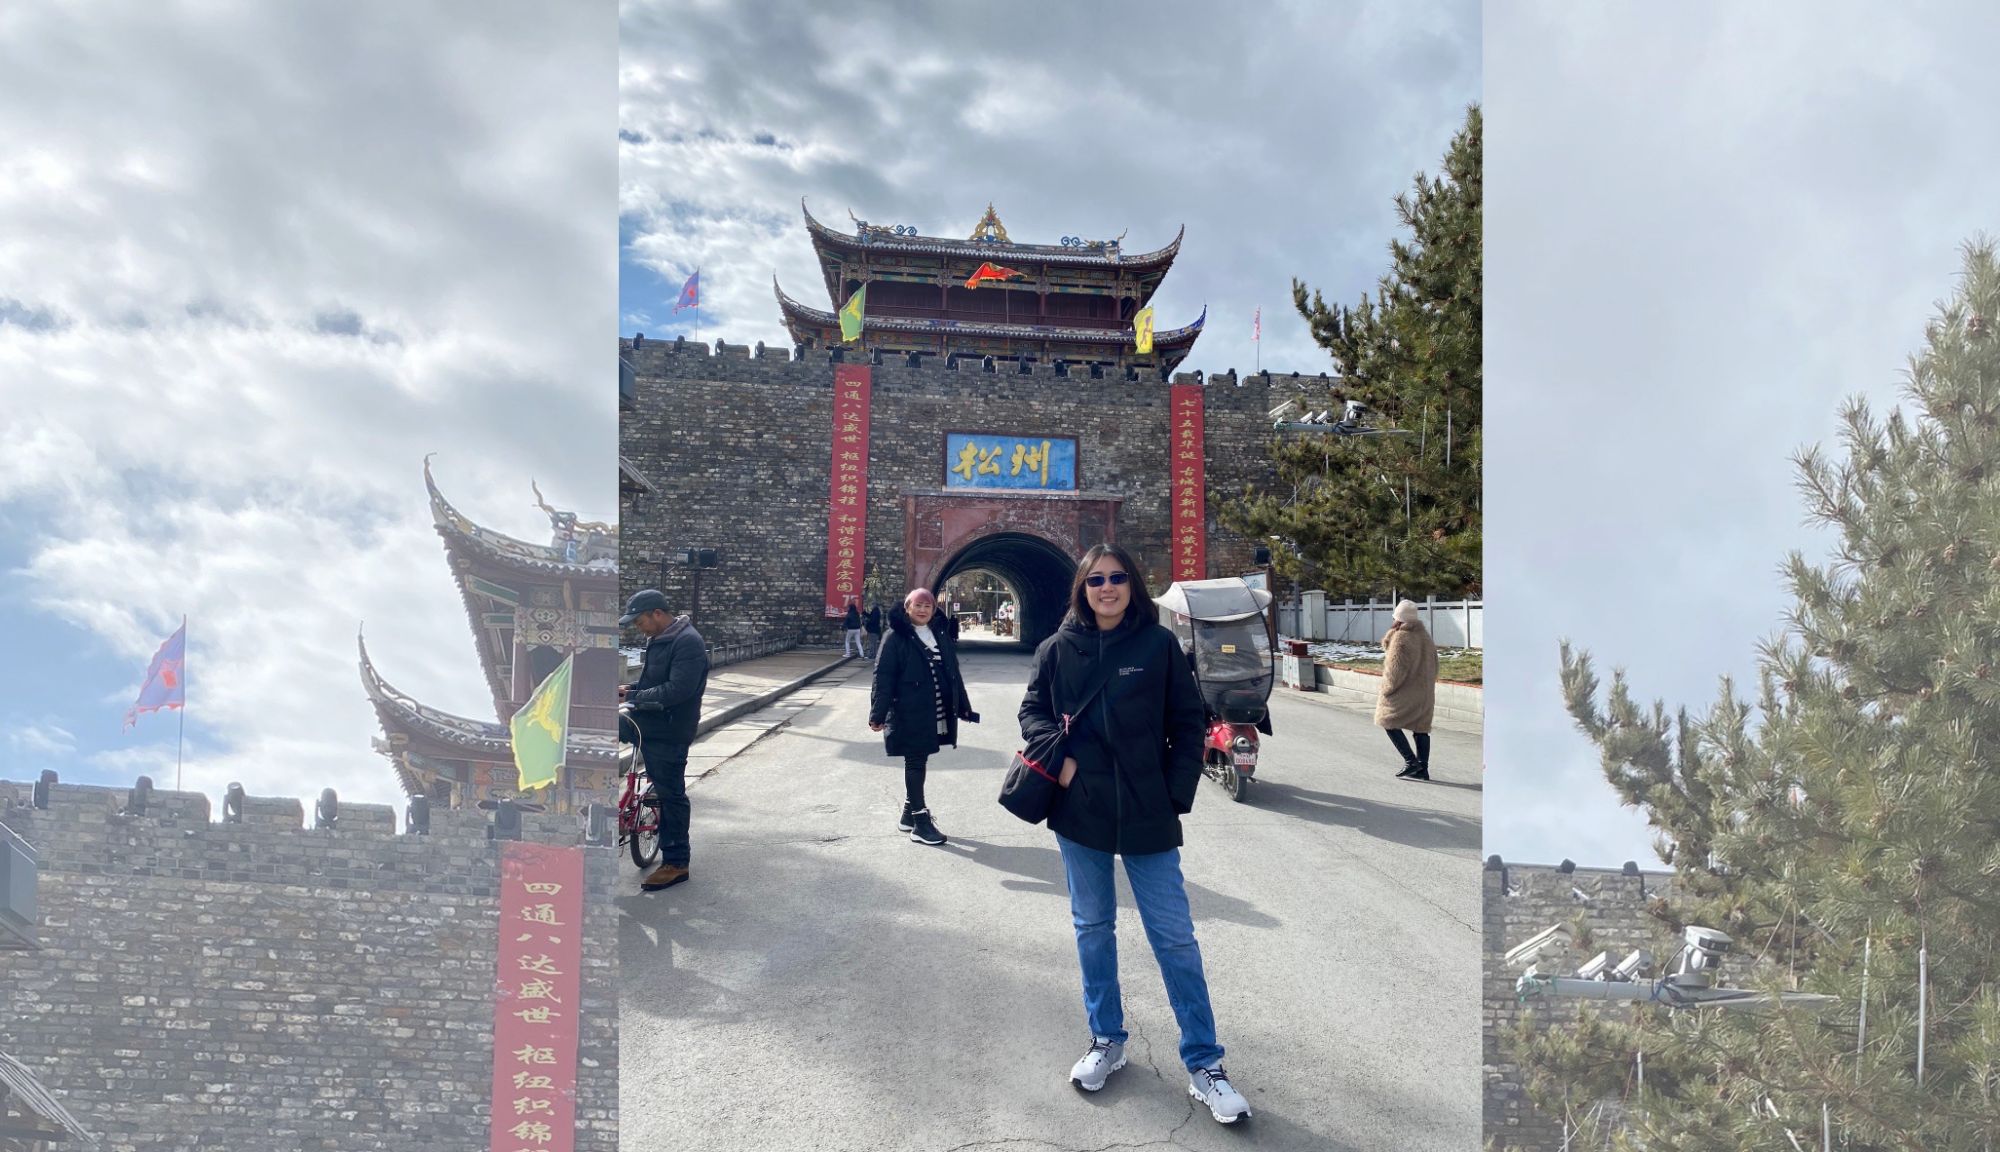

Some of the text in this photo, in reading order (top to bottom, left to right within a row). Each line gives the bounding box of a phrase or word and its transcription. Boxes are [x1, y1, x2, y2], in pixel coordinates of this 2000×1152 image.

[951, 441, 1051, 486] 松州
[1179, 525, 1199, 581] 汉藏羌回共
[507, 882, 566, 1152] 四通八达盛世 枢纽织锦
